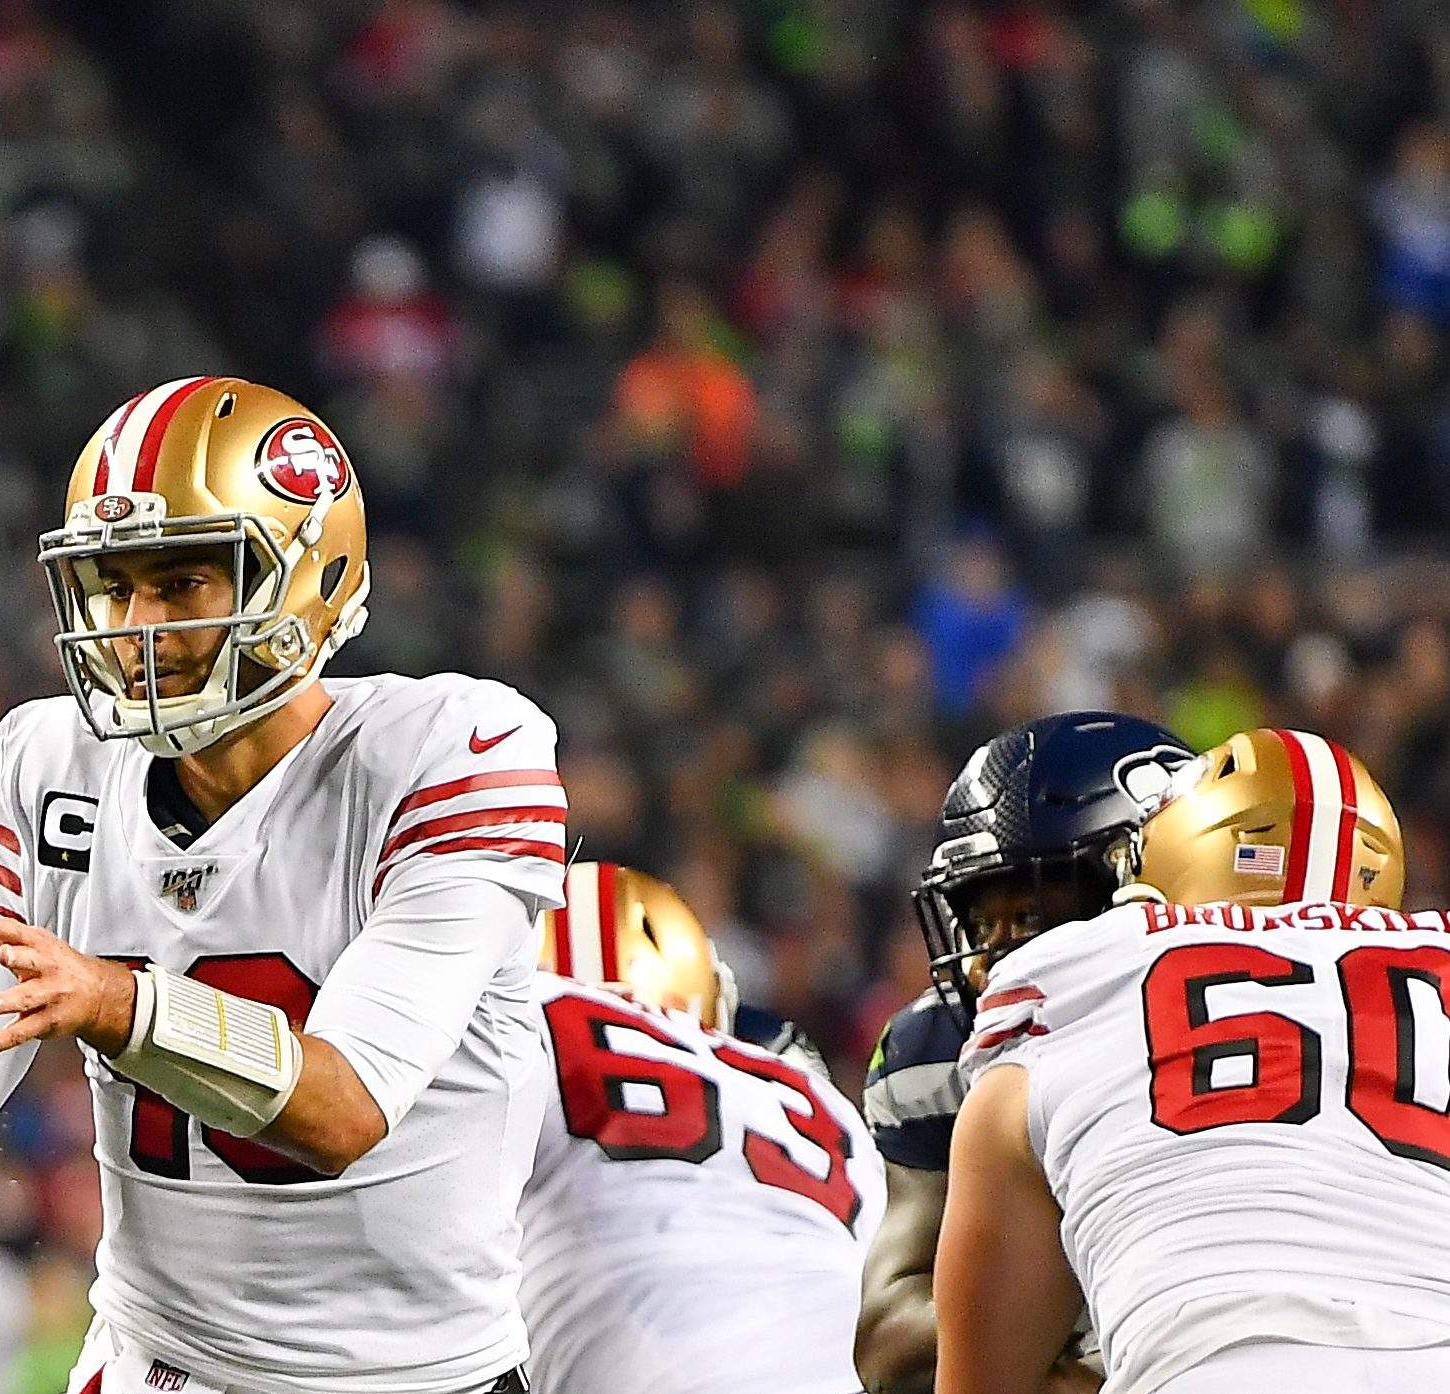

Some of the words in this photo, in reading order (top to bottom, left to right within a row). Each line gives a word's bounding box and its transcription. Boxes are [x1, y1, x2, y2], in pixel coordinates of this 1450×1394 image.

[44, 797, 97, 852] C
[544, 994, 861, 1238] 63
[1143, 943, 1450, 1174] 60
[148, 1367, 183, 1392] NFL
